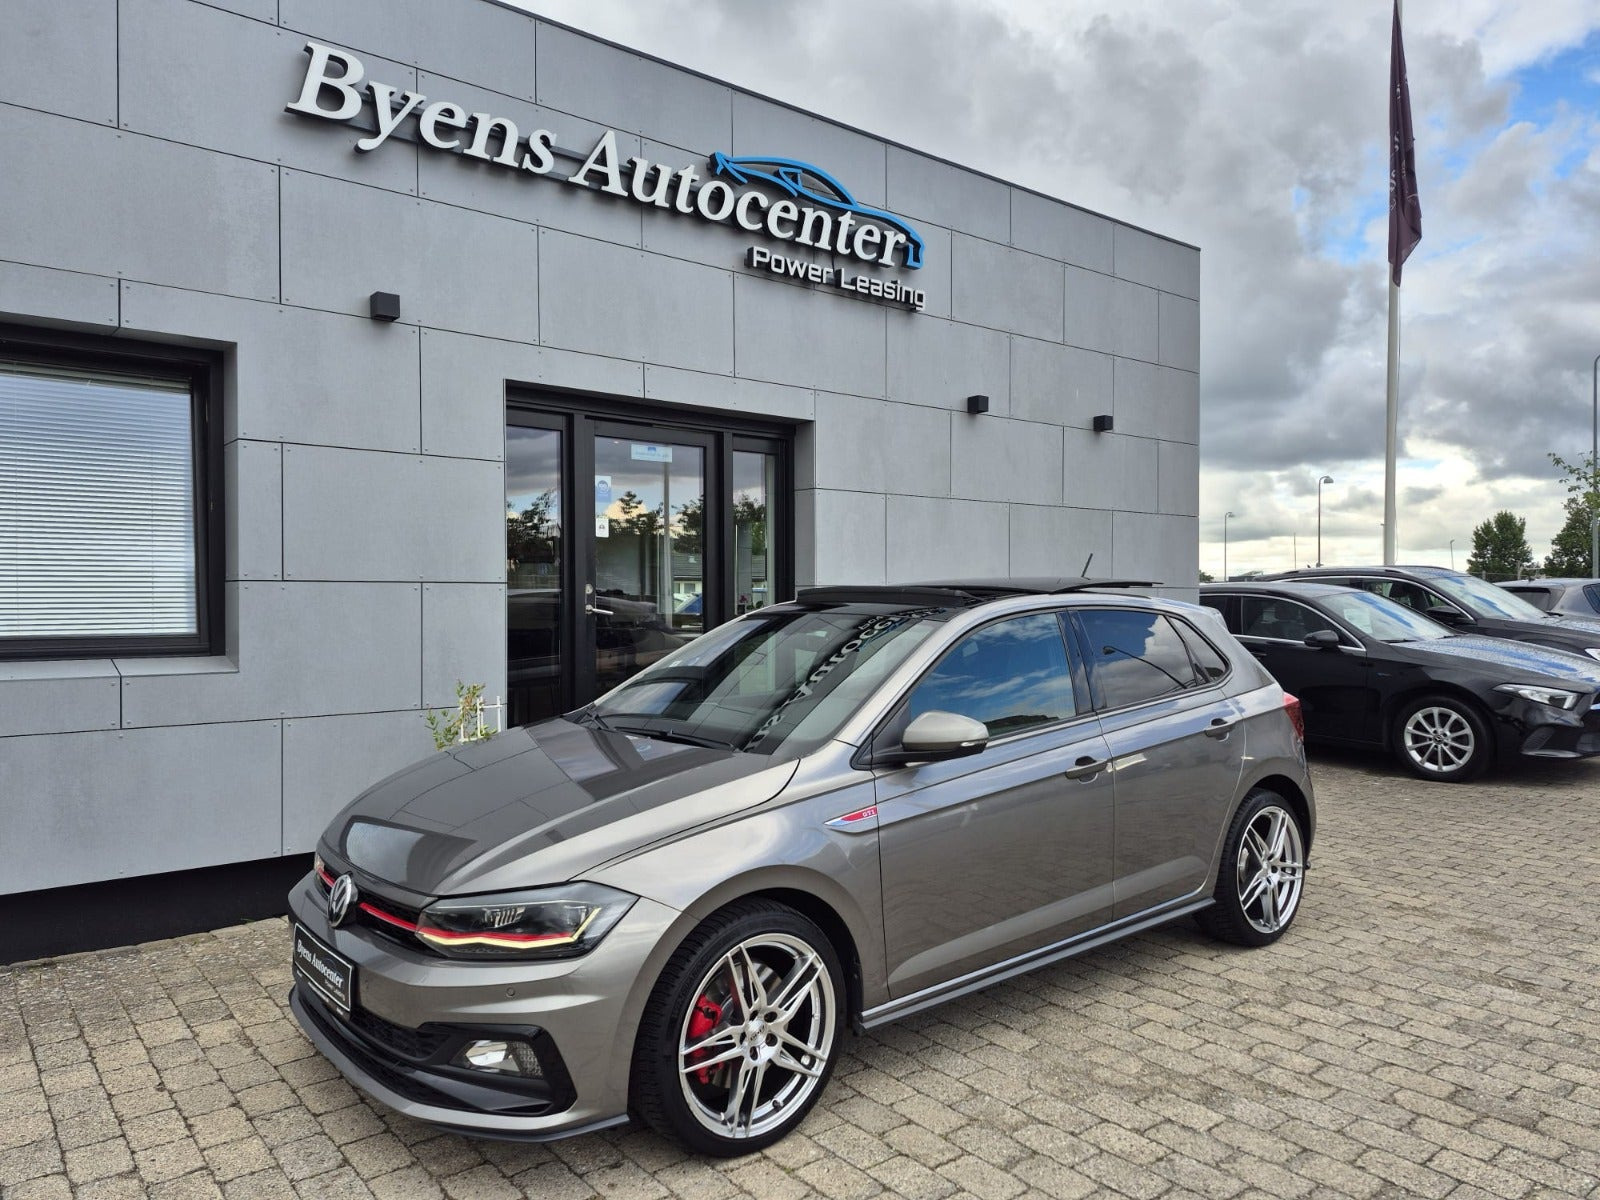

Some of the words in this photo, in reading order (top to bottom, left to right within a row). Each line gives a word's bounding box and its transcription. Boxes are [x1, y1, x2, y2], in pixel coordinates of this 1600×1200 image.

[286, 41, 557, 174] Byens
[568, 129, 906, 267] Autocenter
[751, 245, 834, 284] Power
[840, 267, 926, 311] Leasing
[311, 953, 344, 988] Autocenter
